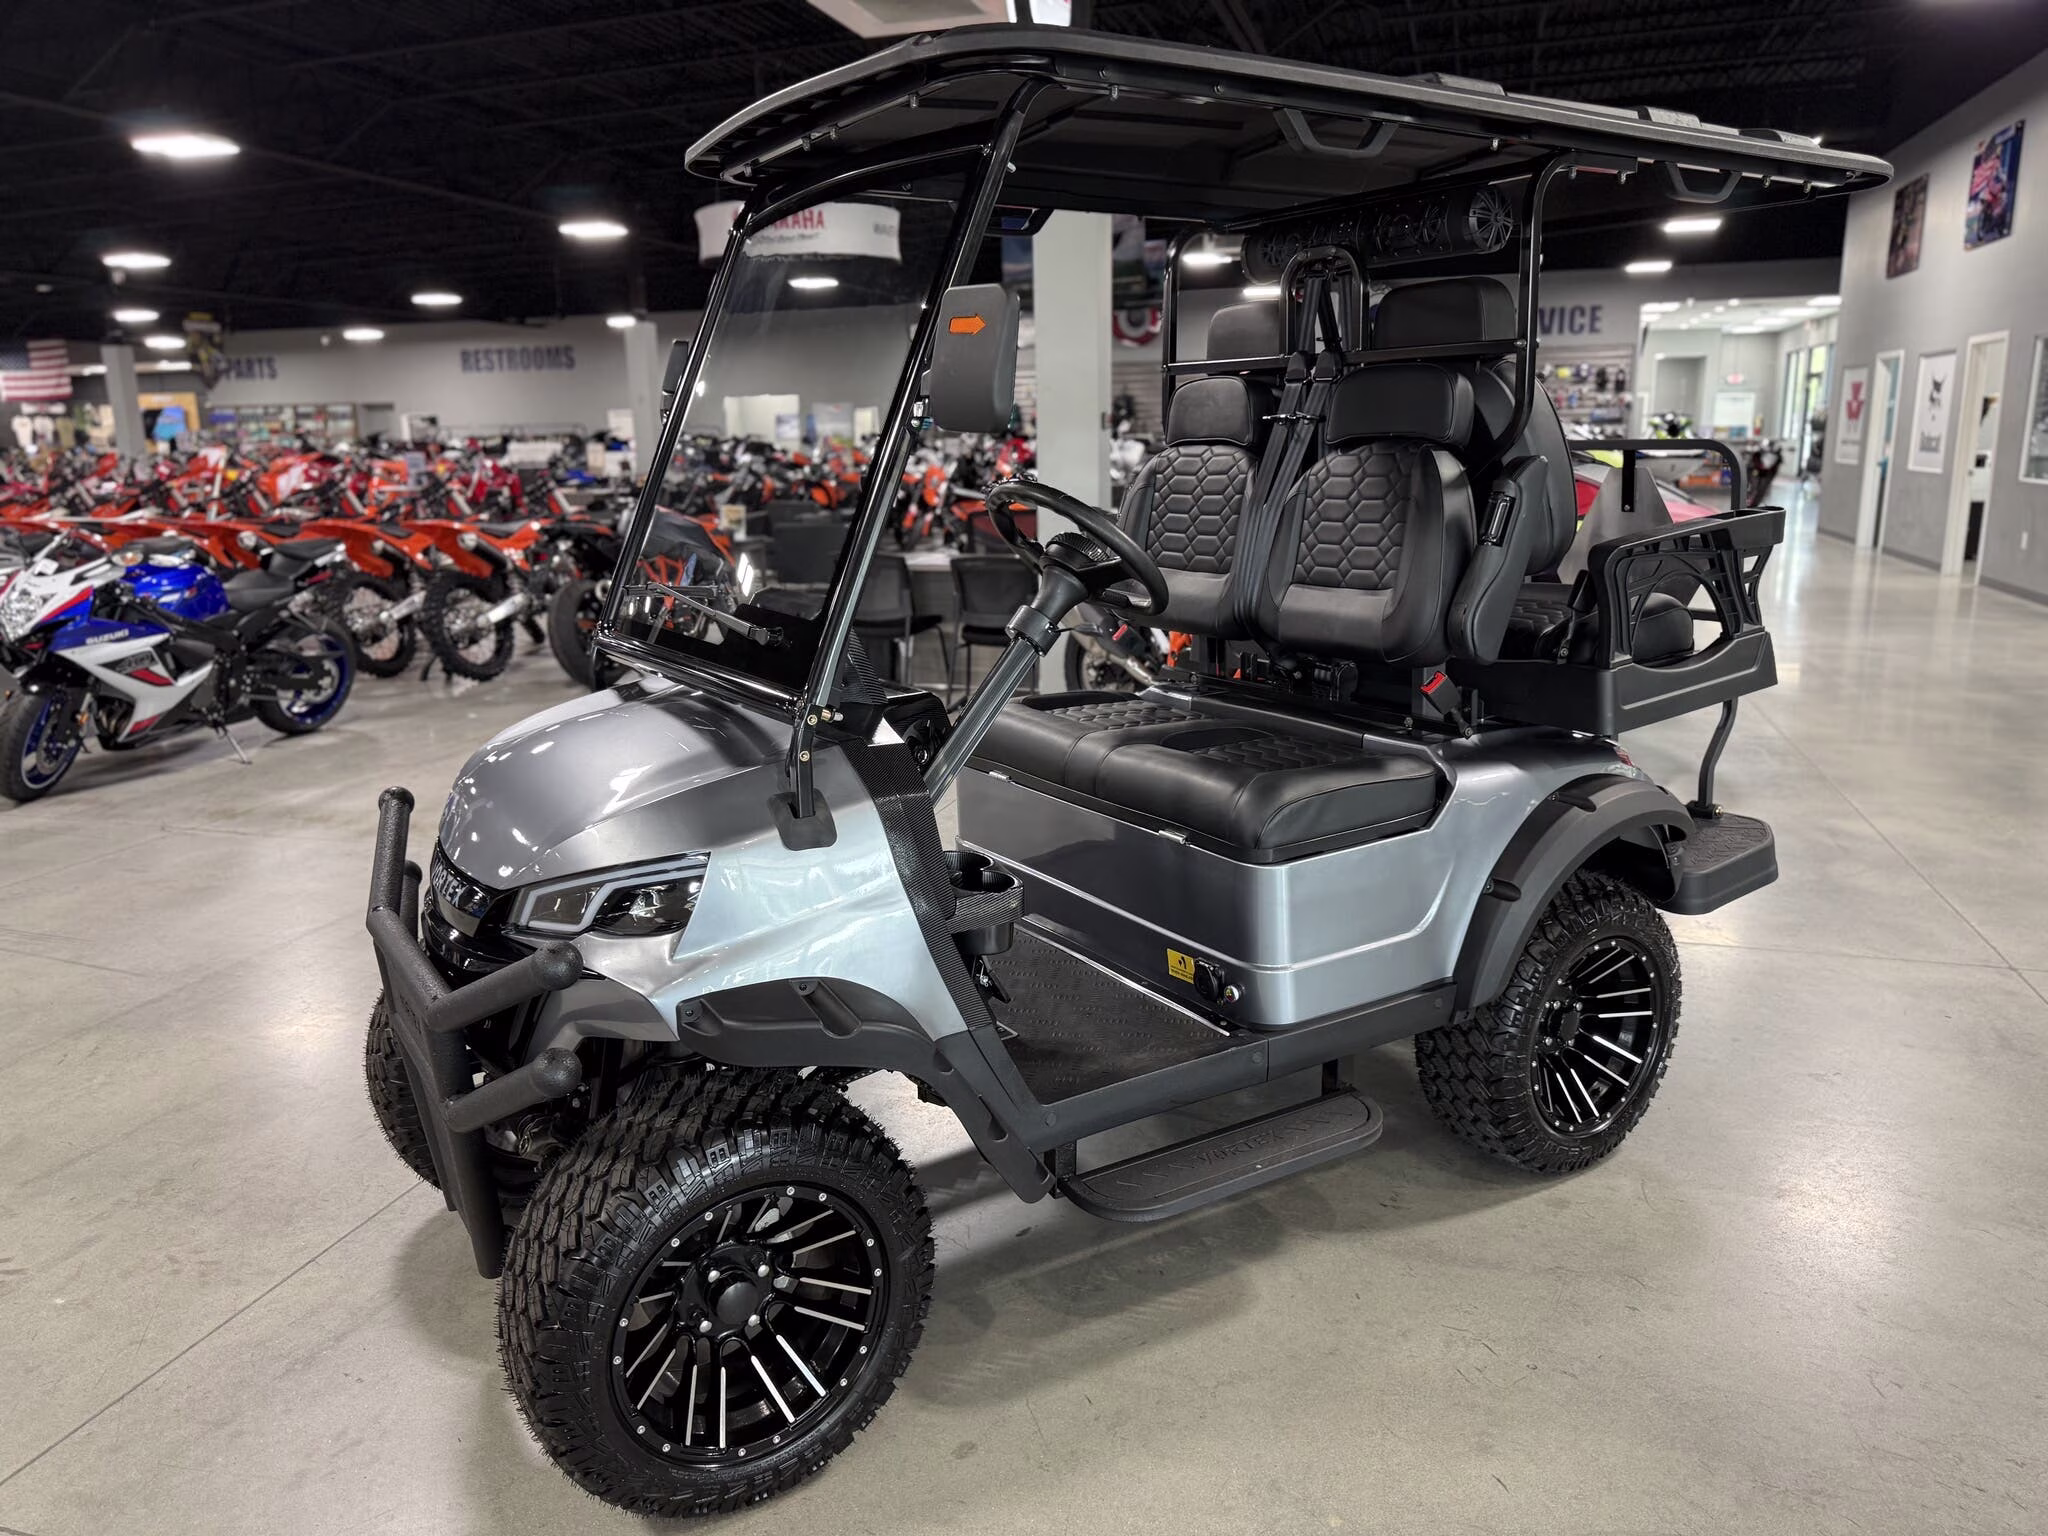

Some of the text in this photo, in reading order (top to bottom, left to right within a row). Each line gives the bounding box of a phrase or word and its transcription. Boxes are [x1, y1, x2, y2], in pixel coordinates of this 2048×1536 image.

[1539, 304, 1603, 335] VICE
[224, 356, 278, 380] PARTS
[460, 345, 576, 372] RESTROOMS
